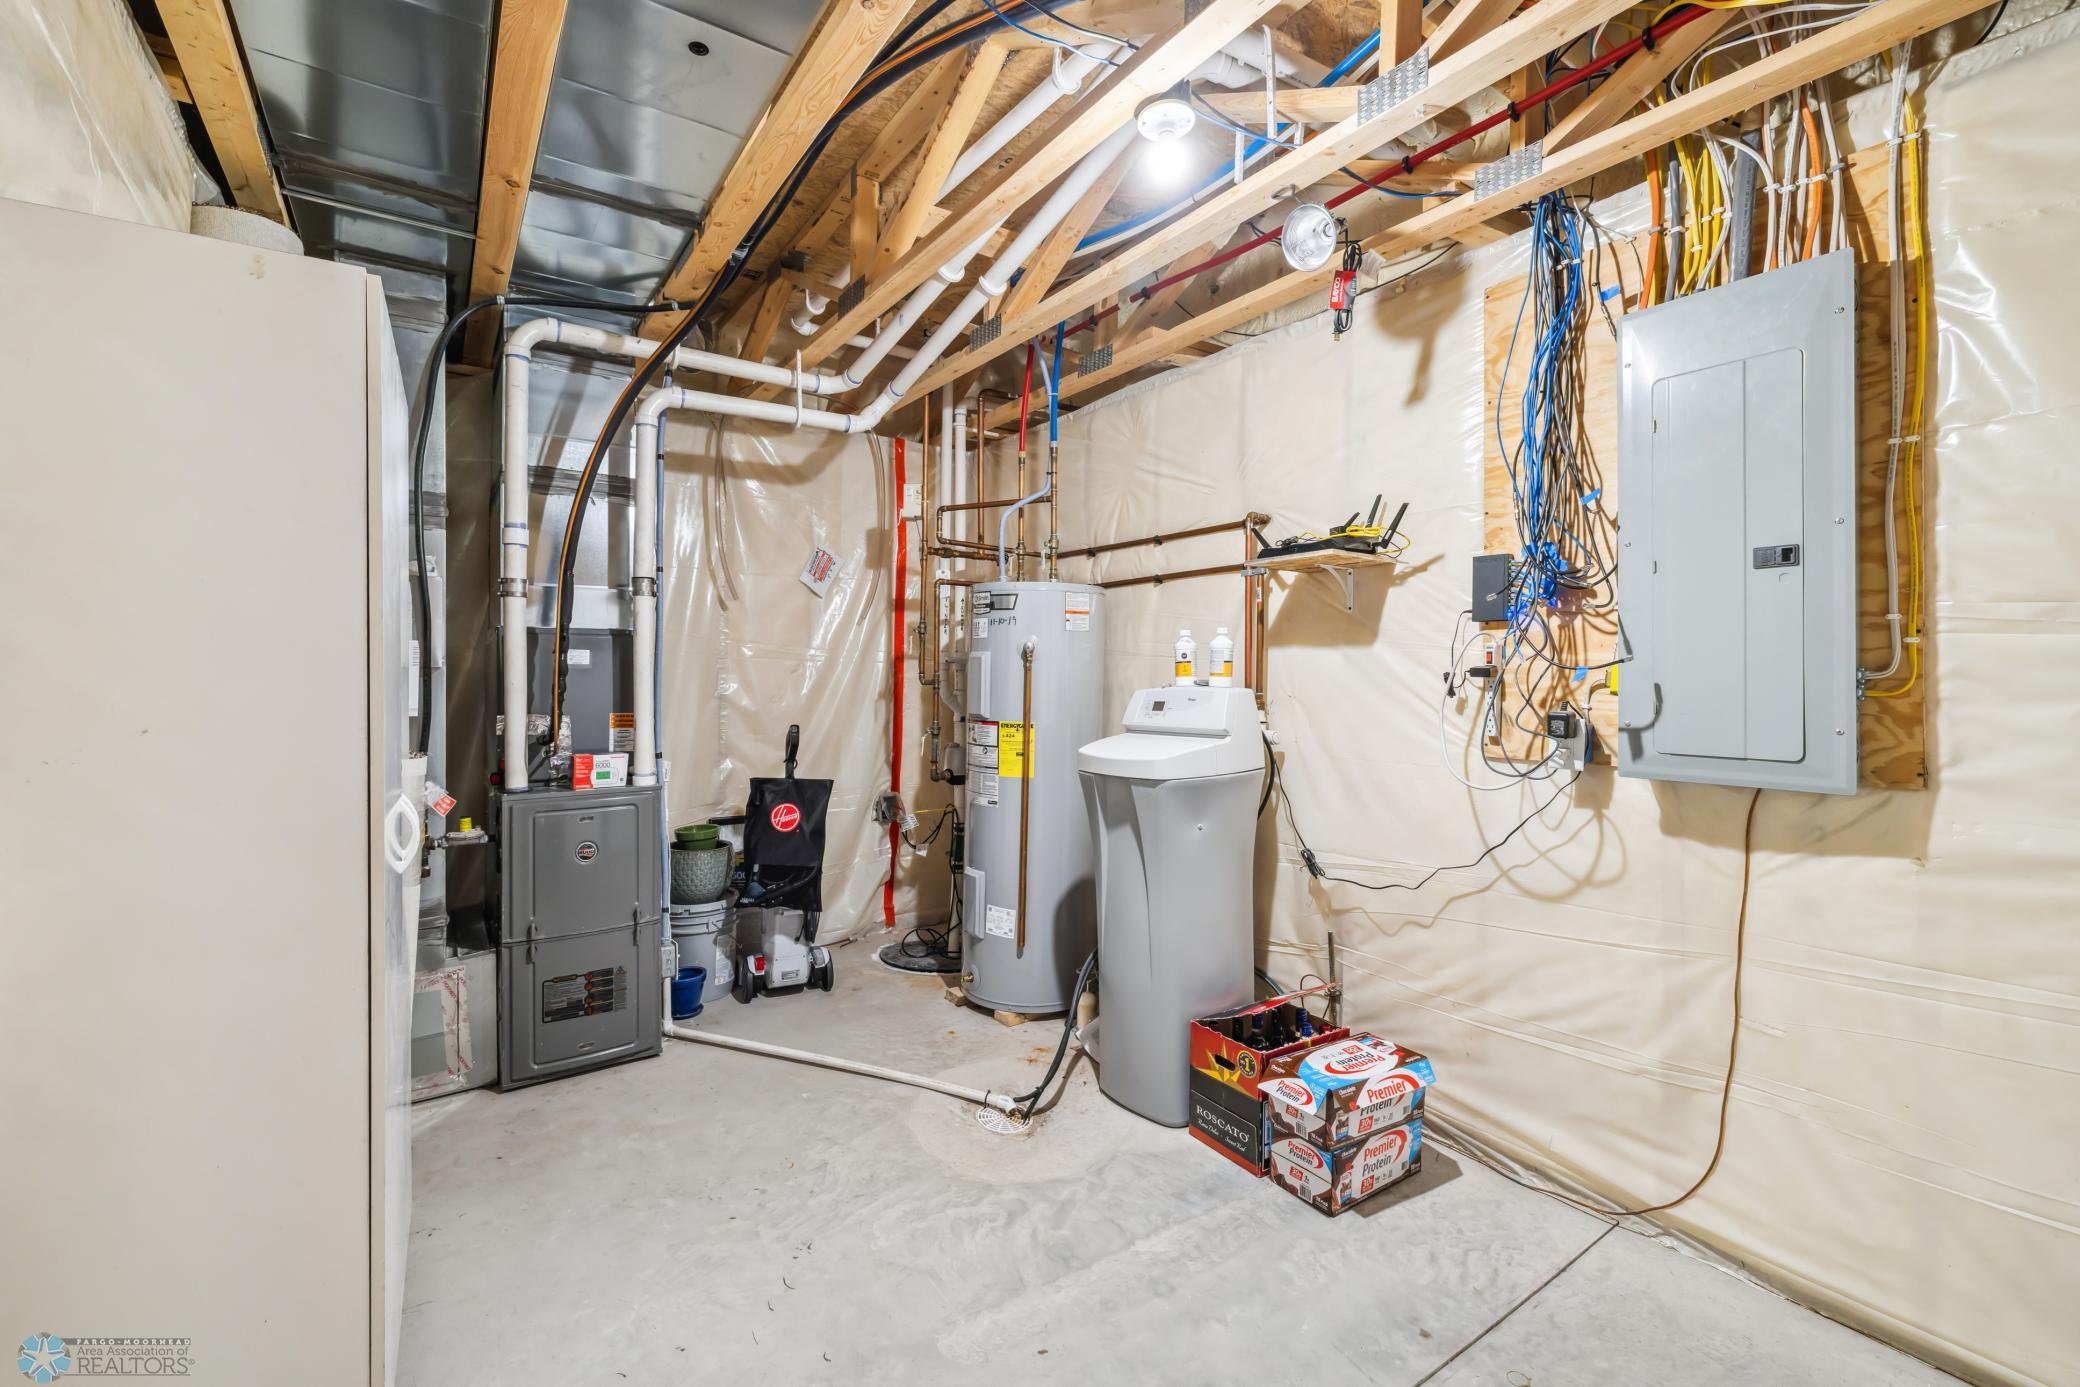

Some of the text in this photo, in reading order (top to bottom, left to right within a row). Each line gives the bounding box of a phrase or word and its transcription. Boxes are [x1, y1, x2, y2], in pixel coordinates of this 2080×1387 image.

[1331, 277, 1340, 303] BAYCO
[1336, 1052, 1375, 1065] Protein
[1343, 1055, 1386, 1071] Premier
[1276, 1086, 1300, 1102] Protein
[1278, 1080, 1305, 1098] Premier
[1367, 1080, 1407, 1103] Premier
[1196, 1105, 1249, 1143] ROSCATO
[1288, 1141, 1315, 1160] Premier
[1289, 1148, 1313, 1166] Protein
[1364, 1137, 1397, 1162] Premier
[1362, 1154, 1391, 1177] Protein
